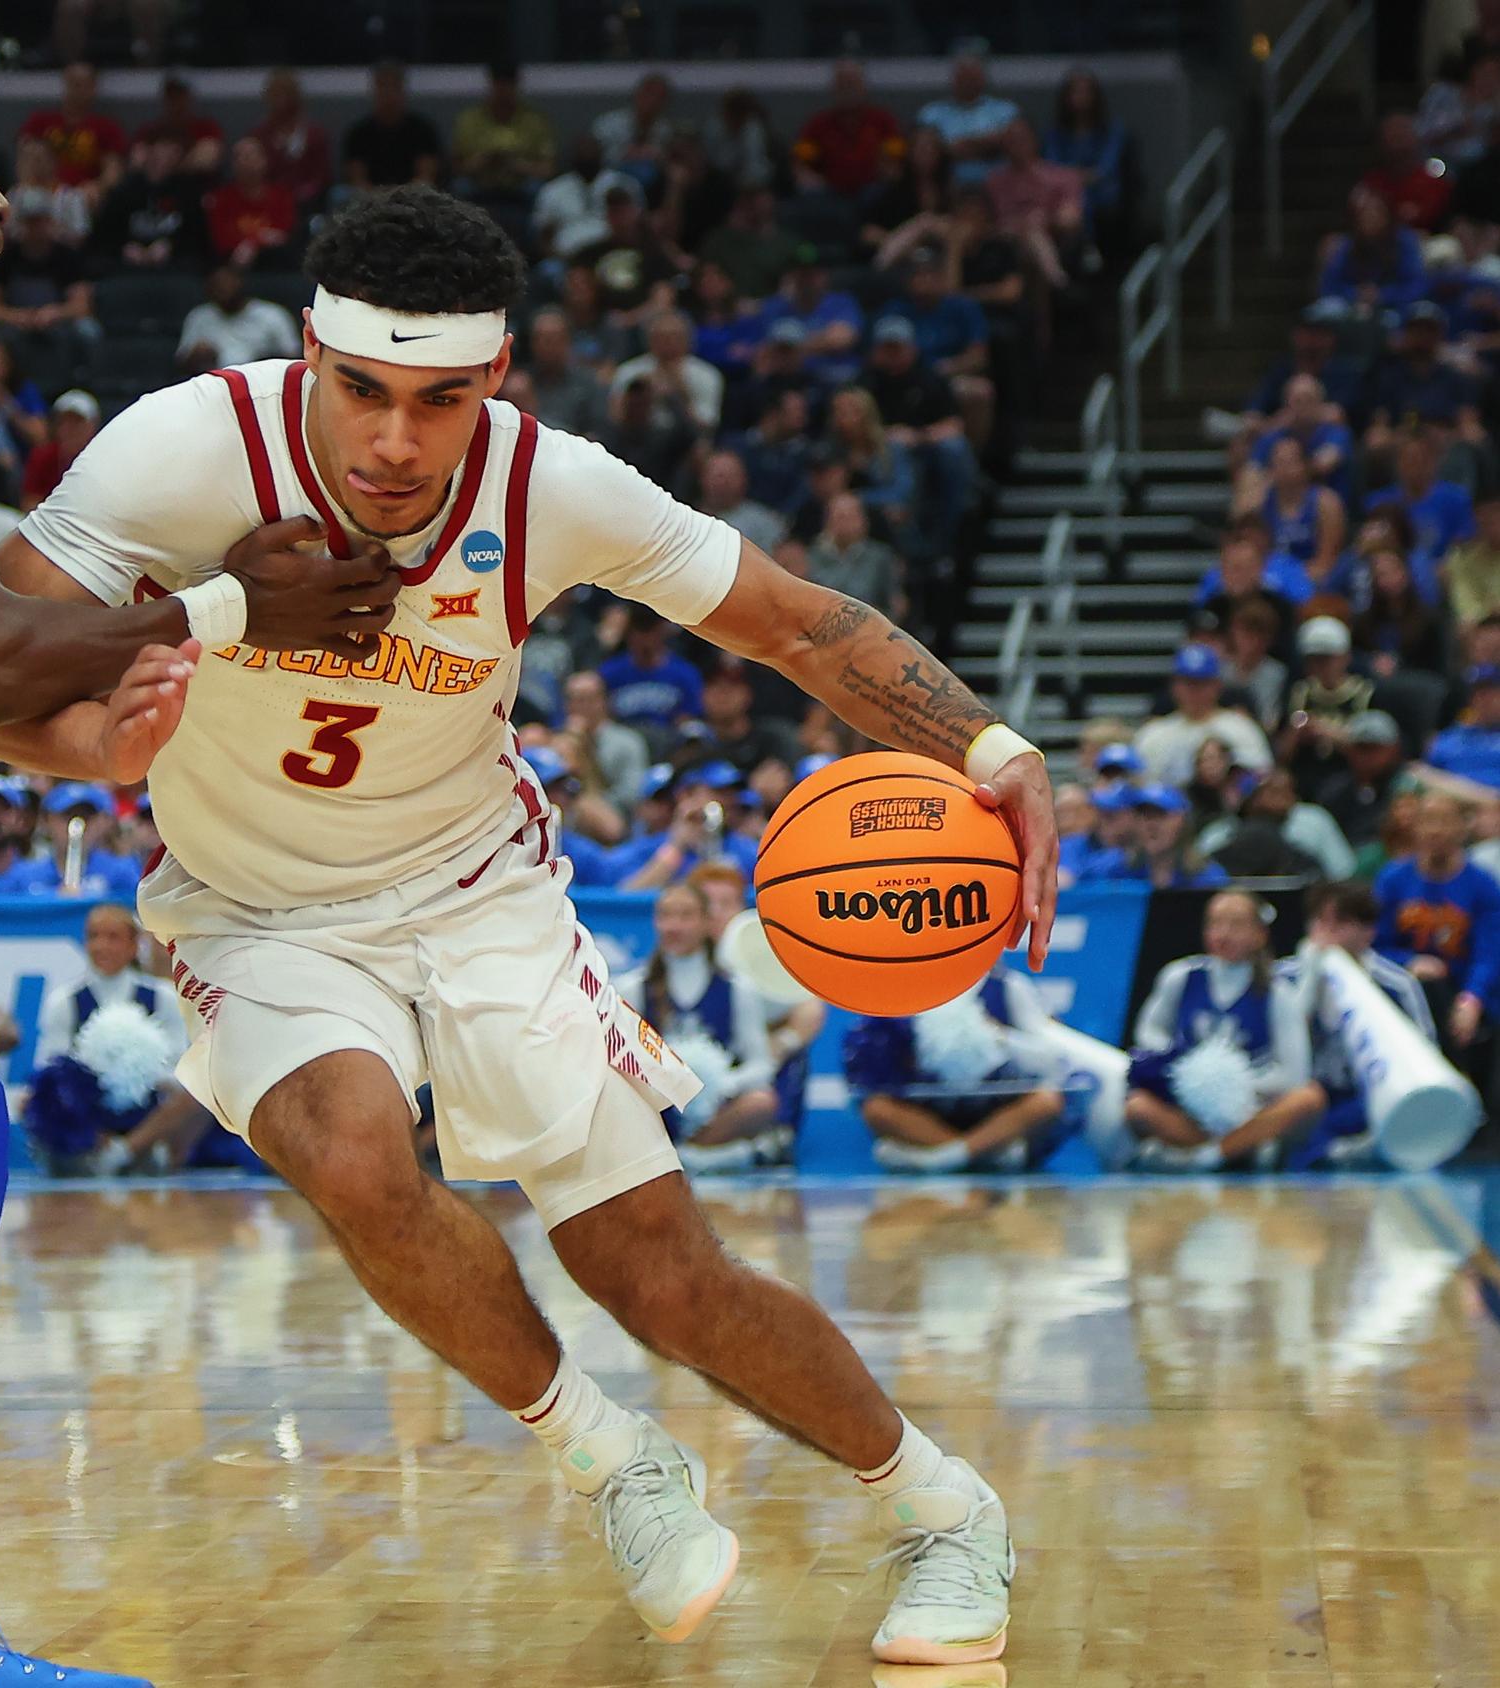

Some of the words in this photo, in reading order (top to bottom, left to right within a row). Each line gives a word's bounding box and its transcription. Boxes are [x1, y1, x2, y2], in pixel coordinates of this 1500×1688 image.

[466, 549, 502, 563] NCAA
[428, 587, 482, 621] XII
[279, 697, 383, 790] 3
[851, 799, 922, 821] MADNESS
[876, 814, 929, 830] MARCH
[876, 879, 902, 887] NXT
[906, 877, 931, 886] EVO
[815, 880, 990, 935] Wilson
